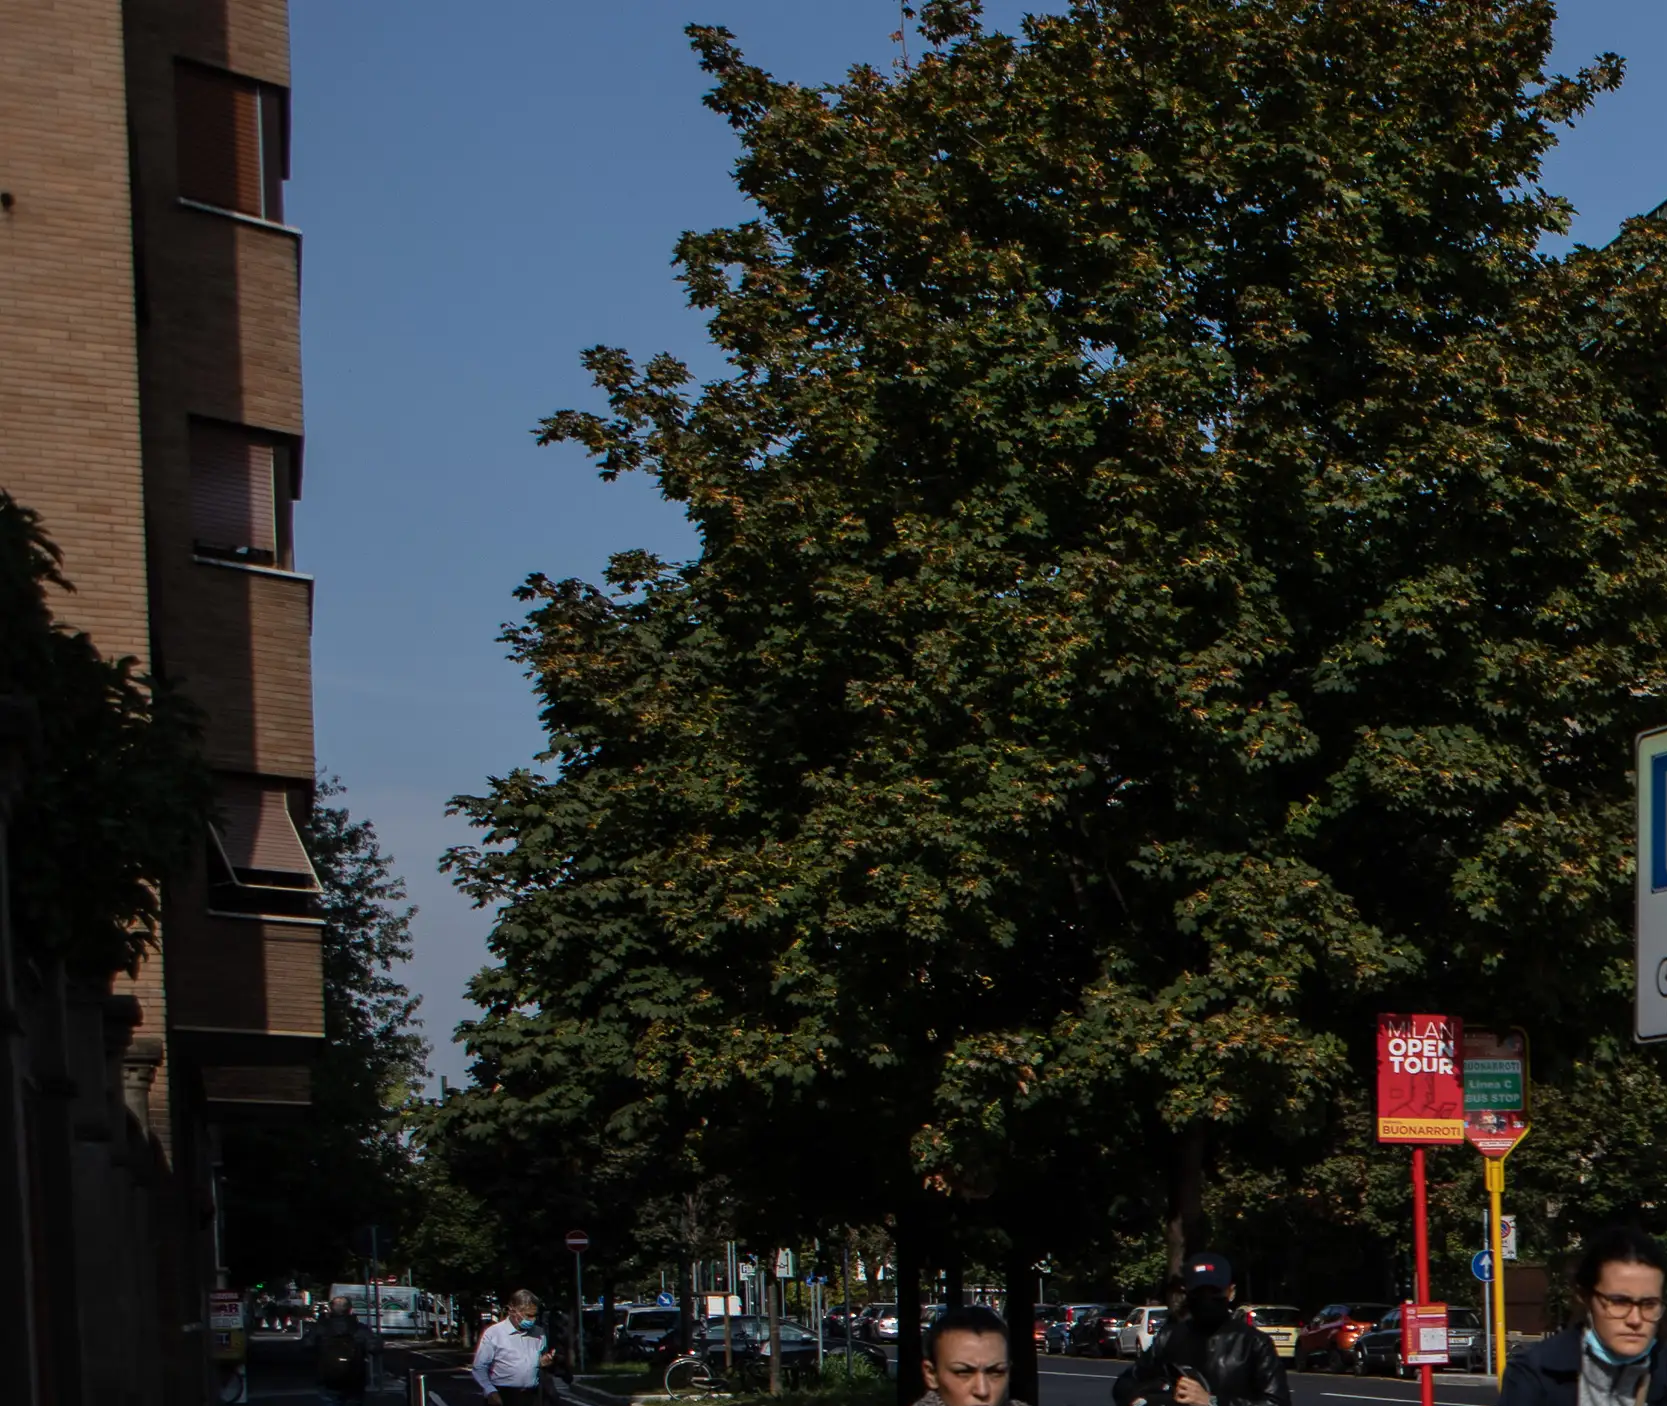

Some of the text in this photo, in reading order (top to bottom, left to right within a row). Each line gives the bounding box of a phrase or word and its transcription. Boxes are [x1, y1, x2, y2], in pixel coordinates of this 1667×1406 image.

[1388, 1021, 1455, 1039] MILAN
[1388, 1039, 1455, 1057] OPEN
[1389, 1057, 1454, 1074] TOUR
[1469, 1080, 1513, 1088] Linea C
[1464, 1094, 1520, 1103] BUS STOP
[1383, 1125, 1461, 1137] BUONARROTI
